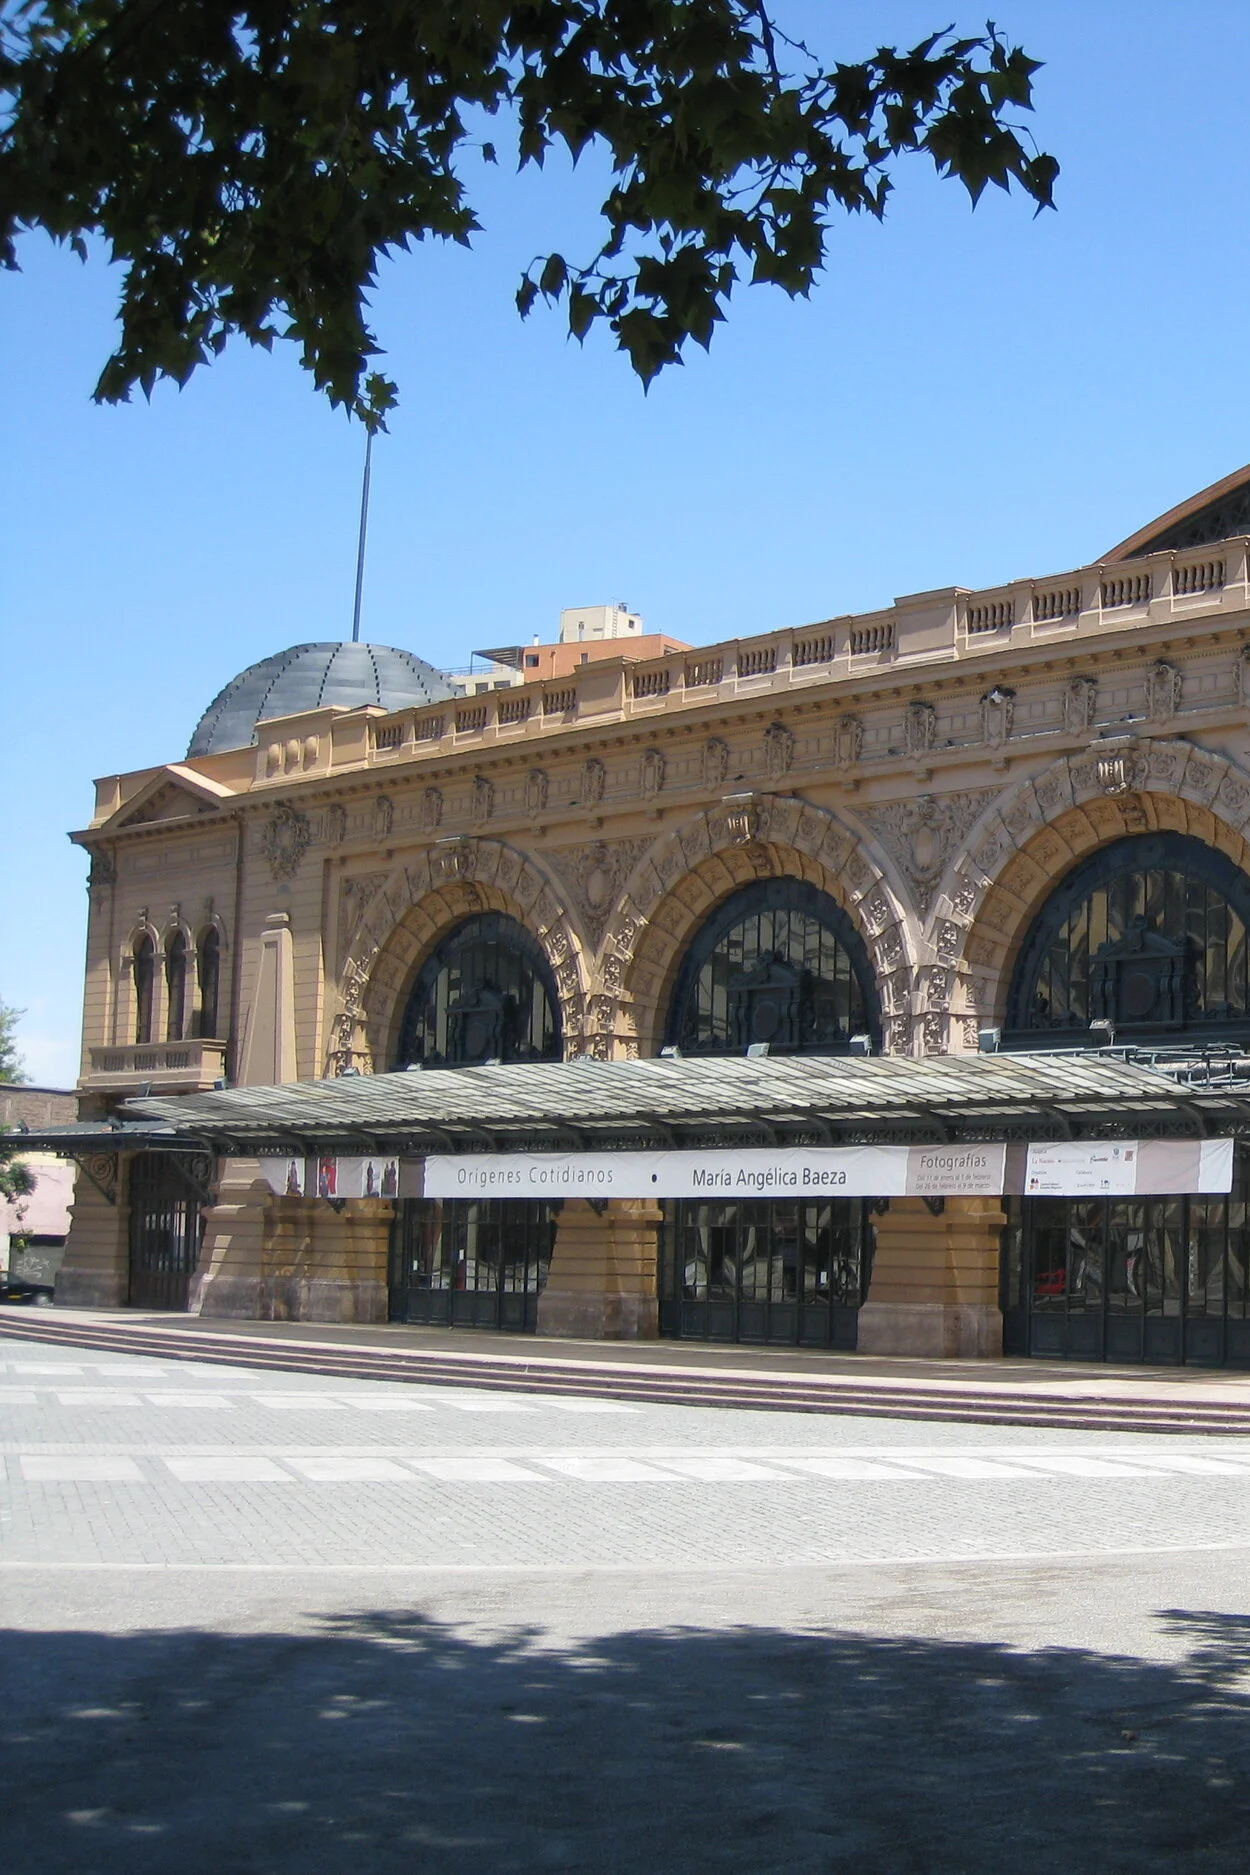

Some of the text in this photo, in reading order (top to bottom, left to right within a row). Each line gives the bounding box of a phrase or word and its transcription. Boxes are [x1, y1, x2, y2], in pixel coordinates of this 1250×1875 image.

[920, 1153, 987, 1172] Fotografías
[457, 1166, 613, 1188] Orígenes Cotidianos
[692, 1167, 847, 1191] María Angélica Baeza
